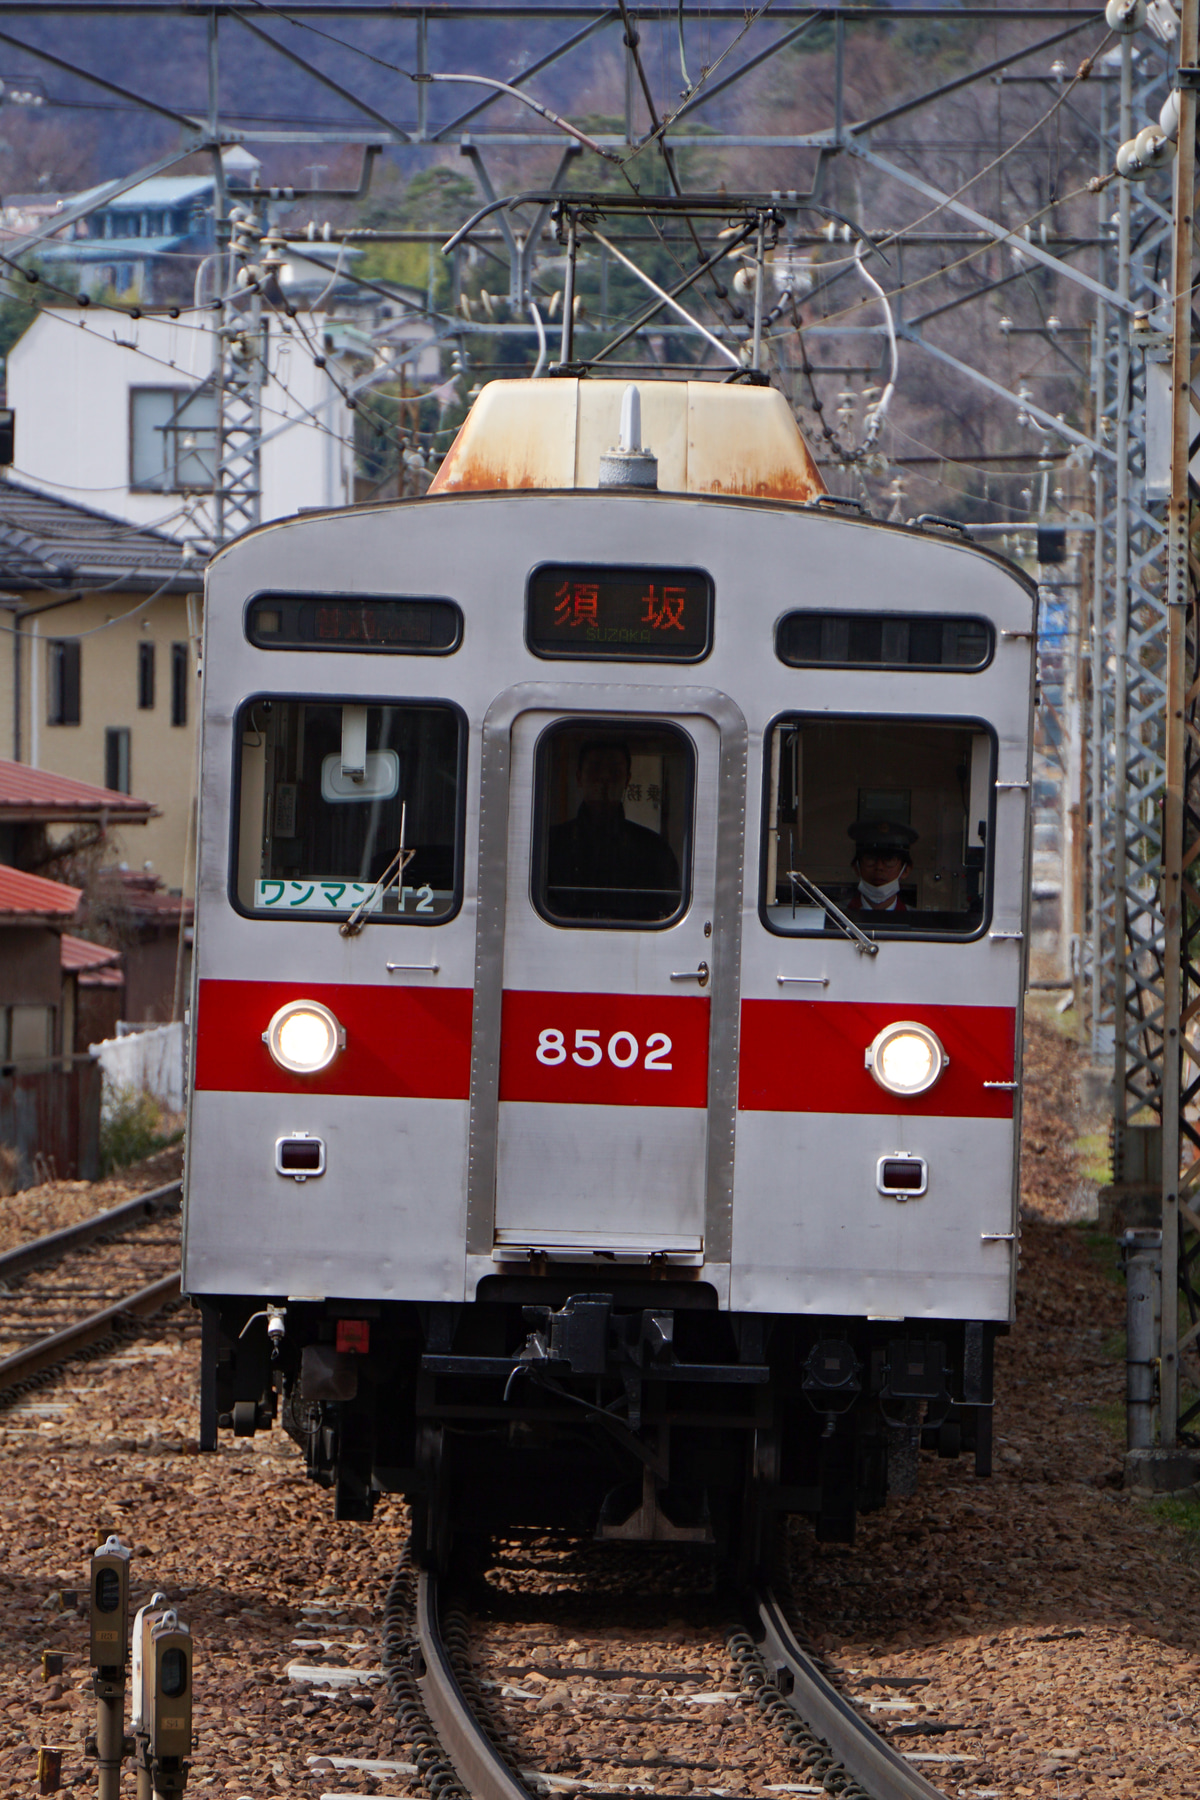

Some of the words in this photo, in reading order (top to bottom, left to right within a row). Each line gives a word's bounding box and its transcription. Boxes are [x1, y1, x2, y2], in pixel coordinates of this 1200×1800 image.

[554, 581, 687, 631] 須坂
[586, 627, 652, 644] SUZAKA
[260, 880, 377, 908] ワンマン
[391, 885, 434, 913] T2
[535, 1028, 673, 1071] 8502
